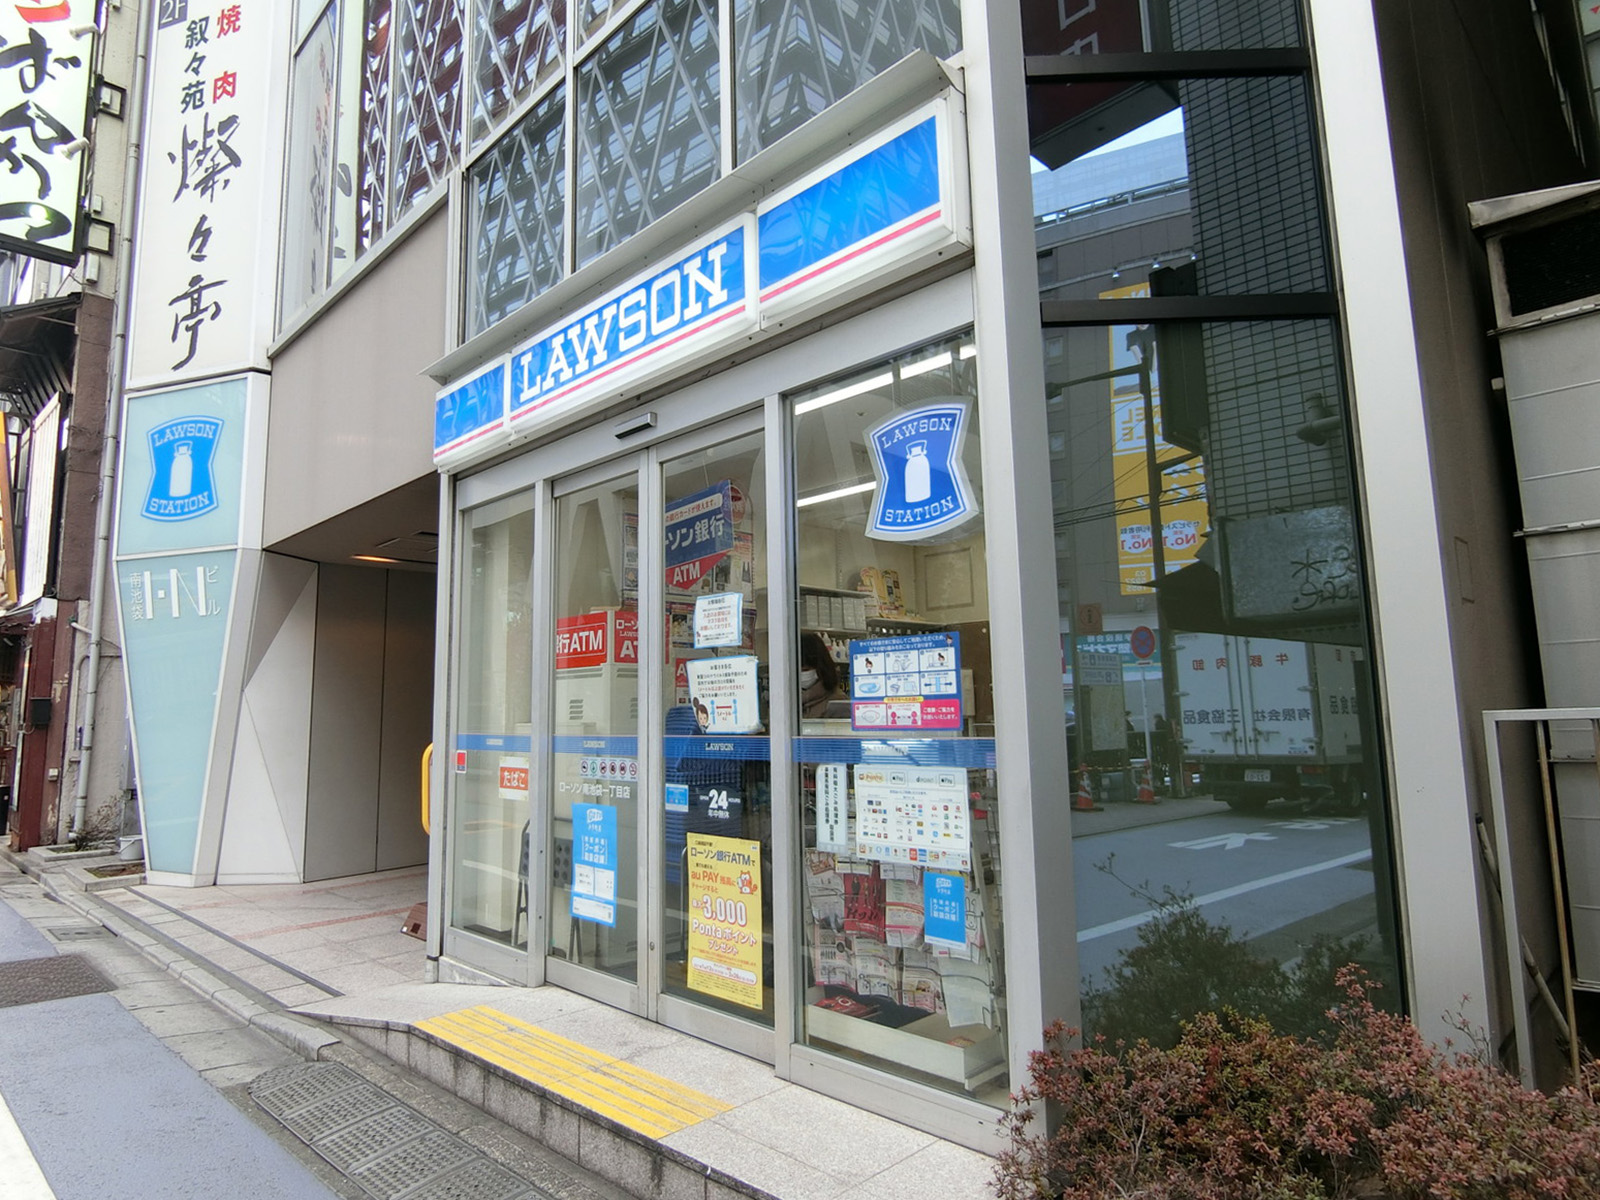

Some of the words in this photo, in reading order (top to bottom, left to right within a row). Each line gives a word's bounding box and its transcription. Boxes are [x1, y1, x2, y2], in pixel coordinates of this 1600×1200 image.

[180, 15, 210, 114] 叙々苑
[518, 241, 729, 402] LAWSON
[153, 423, 217, 447] LAWSON
[881, 417, 953, 449] LAWSON
[149, 491, 210, 515] STATION
[884, 496, 954, 523] STATION
[672, 560, 701, 585] ATM
[704, 742, 734, 751] LAWSON
[503, 770, 526, 787] たばこ
[708, 788, 728, 810] 24
[691, 871, 701, 879] au
[702, 871, 719, 883] PAY
[702, 894, 747, 927] 3,000
[707, 939, 739, 956] プレゼント
